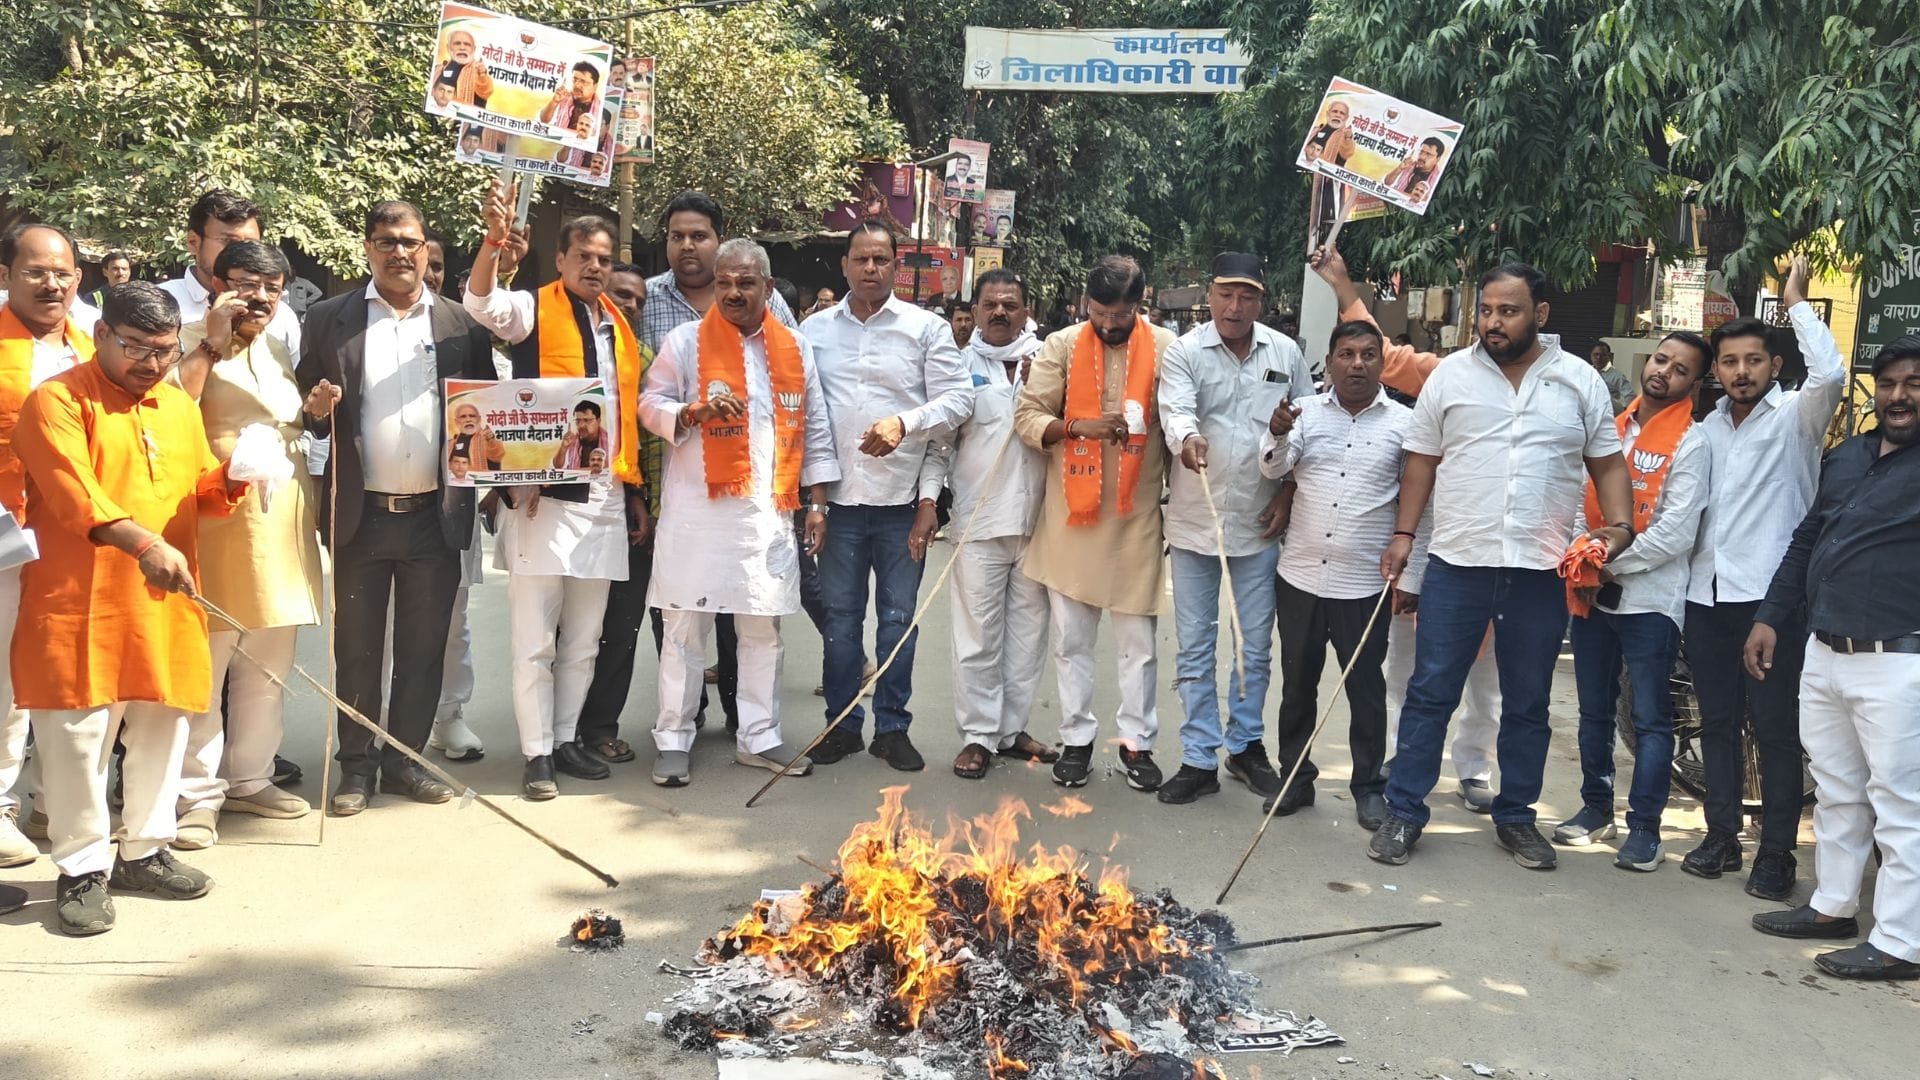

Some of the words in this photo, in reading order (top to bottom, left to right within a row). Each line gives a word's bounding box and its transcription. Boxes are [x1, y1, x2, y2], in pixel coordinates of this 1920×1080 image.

[1113, 32, 1226, 54] कार्यालय
[482, 43, 503, 64] मोदी
[504, 50, 515, 65] जी
[516, 51, 525, 68] के
[526, 57, 556, 75] सम्मान
[556, 61, 567, 77] में
[1001, 58, 1195, 85] जिलाधिकारी
[1203, 64, 1239, 85] वा
[488, 64, 518, 84] भाजपा
[519, 71, 546, 91] मैदान
[547, 77, 559, 92] में
[477, 111, 507, 127] भाजपा
[508, 117, 532, 132] काशी
[532, 123, 550, 136] क्षेत्र
[1352, 115, 1370, 131] मोदी
[1370, 121, 1379, 133] जी
[1385, 129, 1409, 146] सम्मान
[1408, 136, 1417, 149] में
[1353, 132, 1376, 151] भाजपा
[1377, 140, 1397, 157] मैदान
[1396, 147, 1408, 161] में
[528, 159, 550, 171] काशी
[551, 163, 566, 174] क्षेत्र
[1334, 167, 1358, 183] भाजपा
[1357, 175, 1376, 191] काशी
[1376, 183, 1390, 196] क्षेत्र
[1883, 304, 1920, 321] वाराण
[486, 409, 507, 426] मोदी
[508, 410, 519, 425] जी
[520, 409, 529, 425] के
[530, 412, 559, 425] सम्मान
[559, 408, 568, 424] में
[495, 429, 526, 442] भाजपा
[527, 426, 554, 442] मैदान
[554, 425, 564, 441] में
[709, 425, 744, 438] भाजपा
[494, 472, 523, 482] भाजपा
[525, 469, 547, 481] काशी
[548, 469, 565, 481] क्षेत्र
